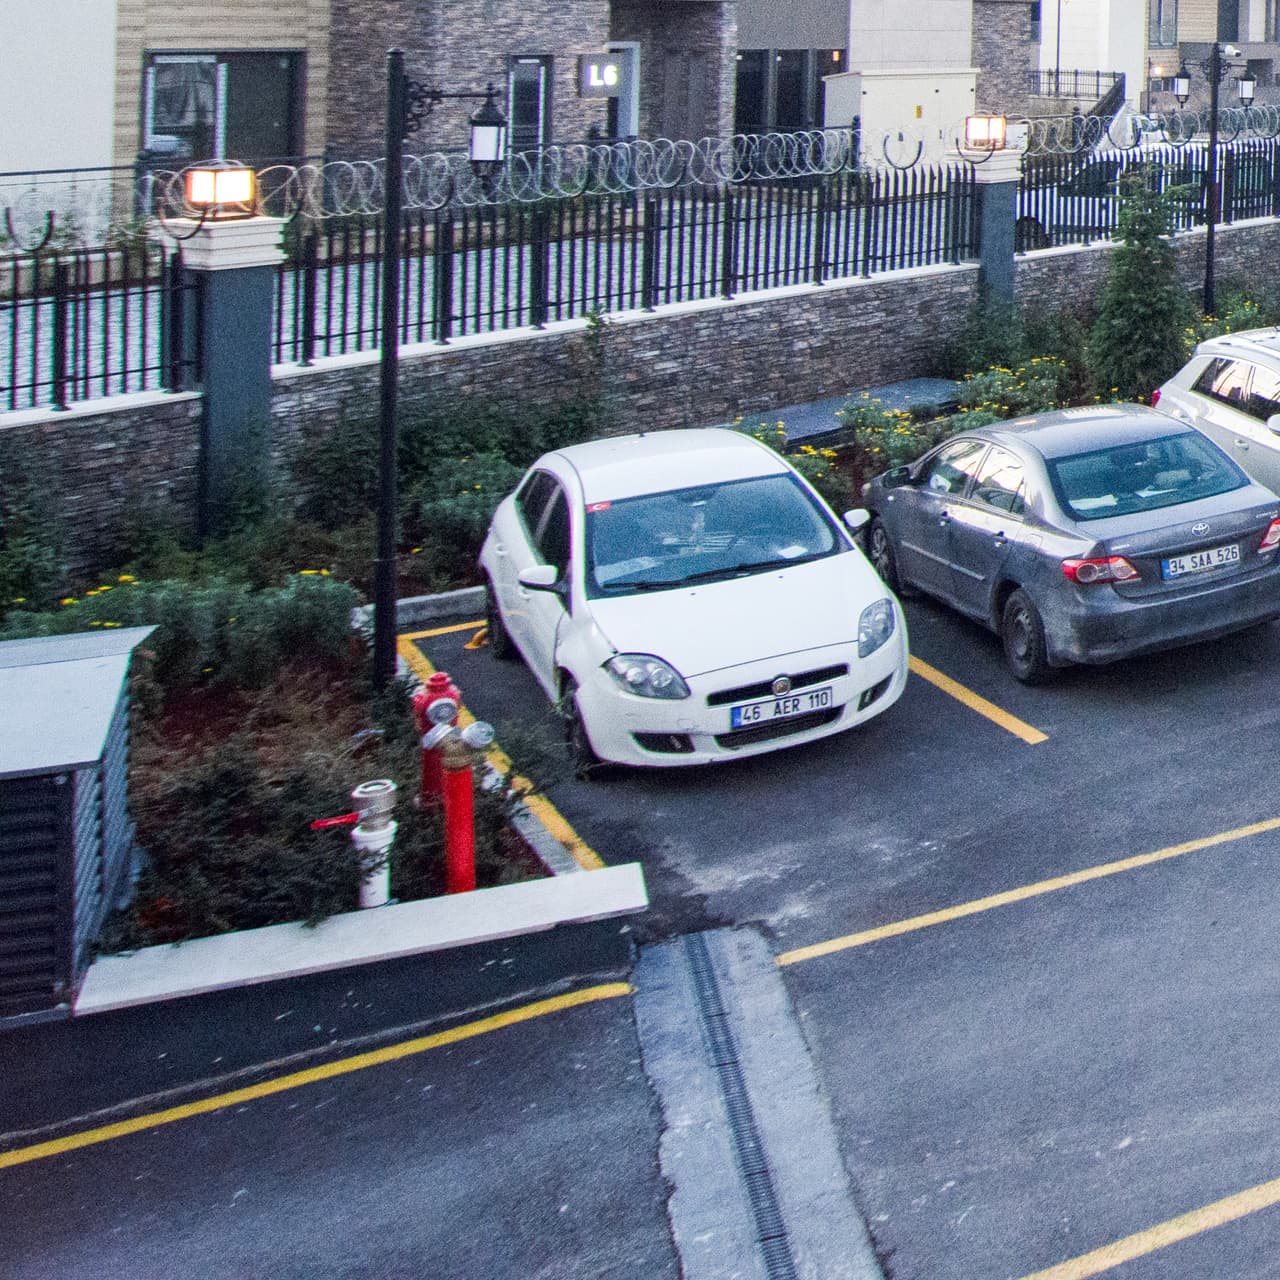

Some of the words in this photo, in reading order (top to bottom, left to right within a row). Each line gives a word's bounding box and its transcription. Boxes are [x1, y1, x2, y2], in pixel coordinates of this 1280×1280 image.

[590, 64, 618, 86] L6
[1170, 559, 1185, 574] 34
[1191, 552, 1212, 569] SAA
[1217, 546, 1238, 562] 526
[743, 706, 761, 722] 46
[773, 698, 800, 717] AER
[809, 692, 828, 709] 110
